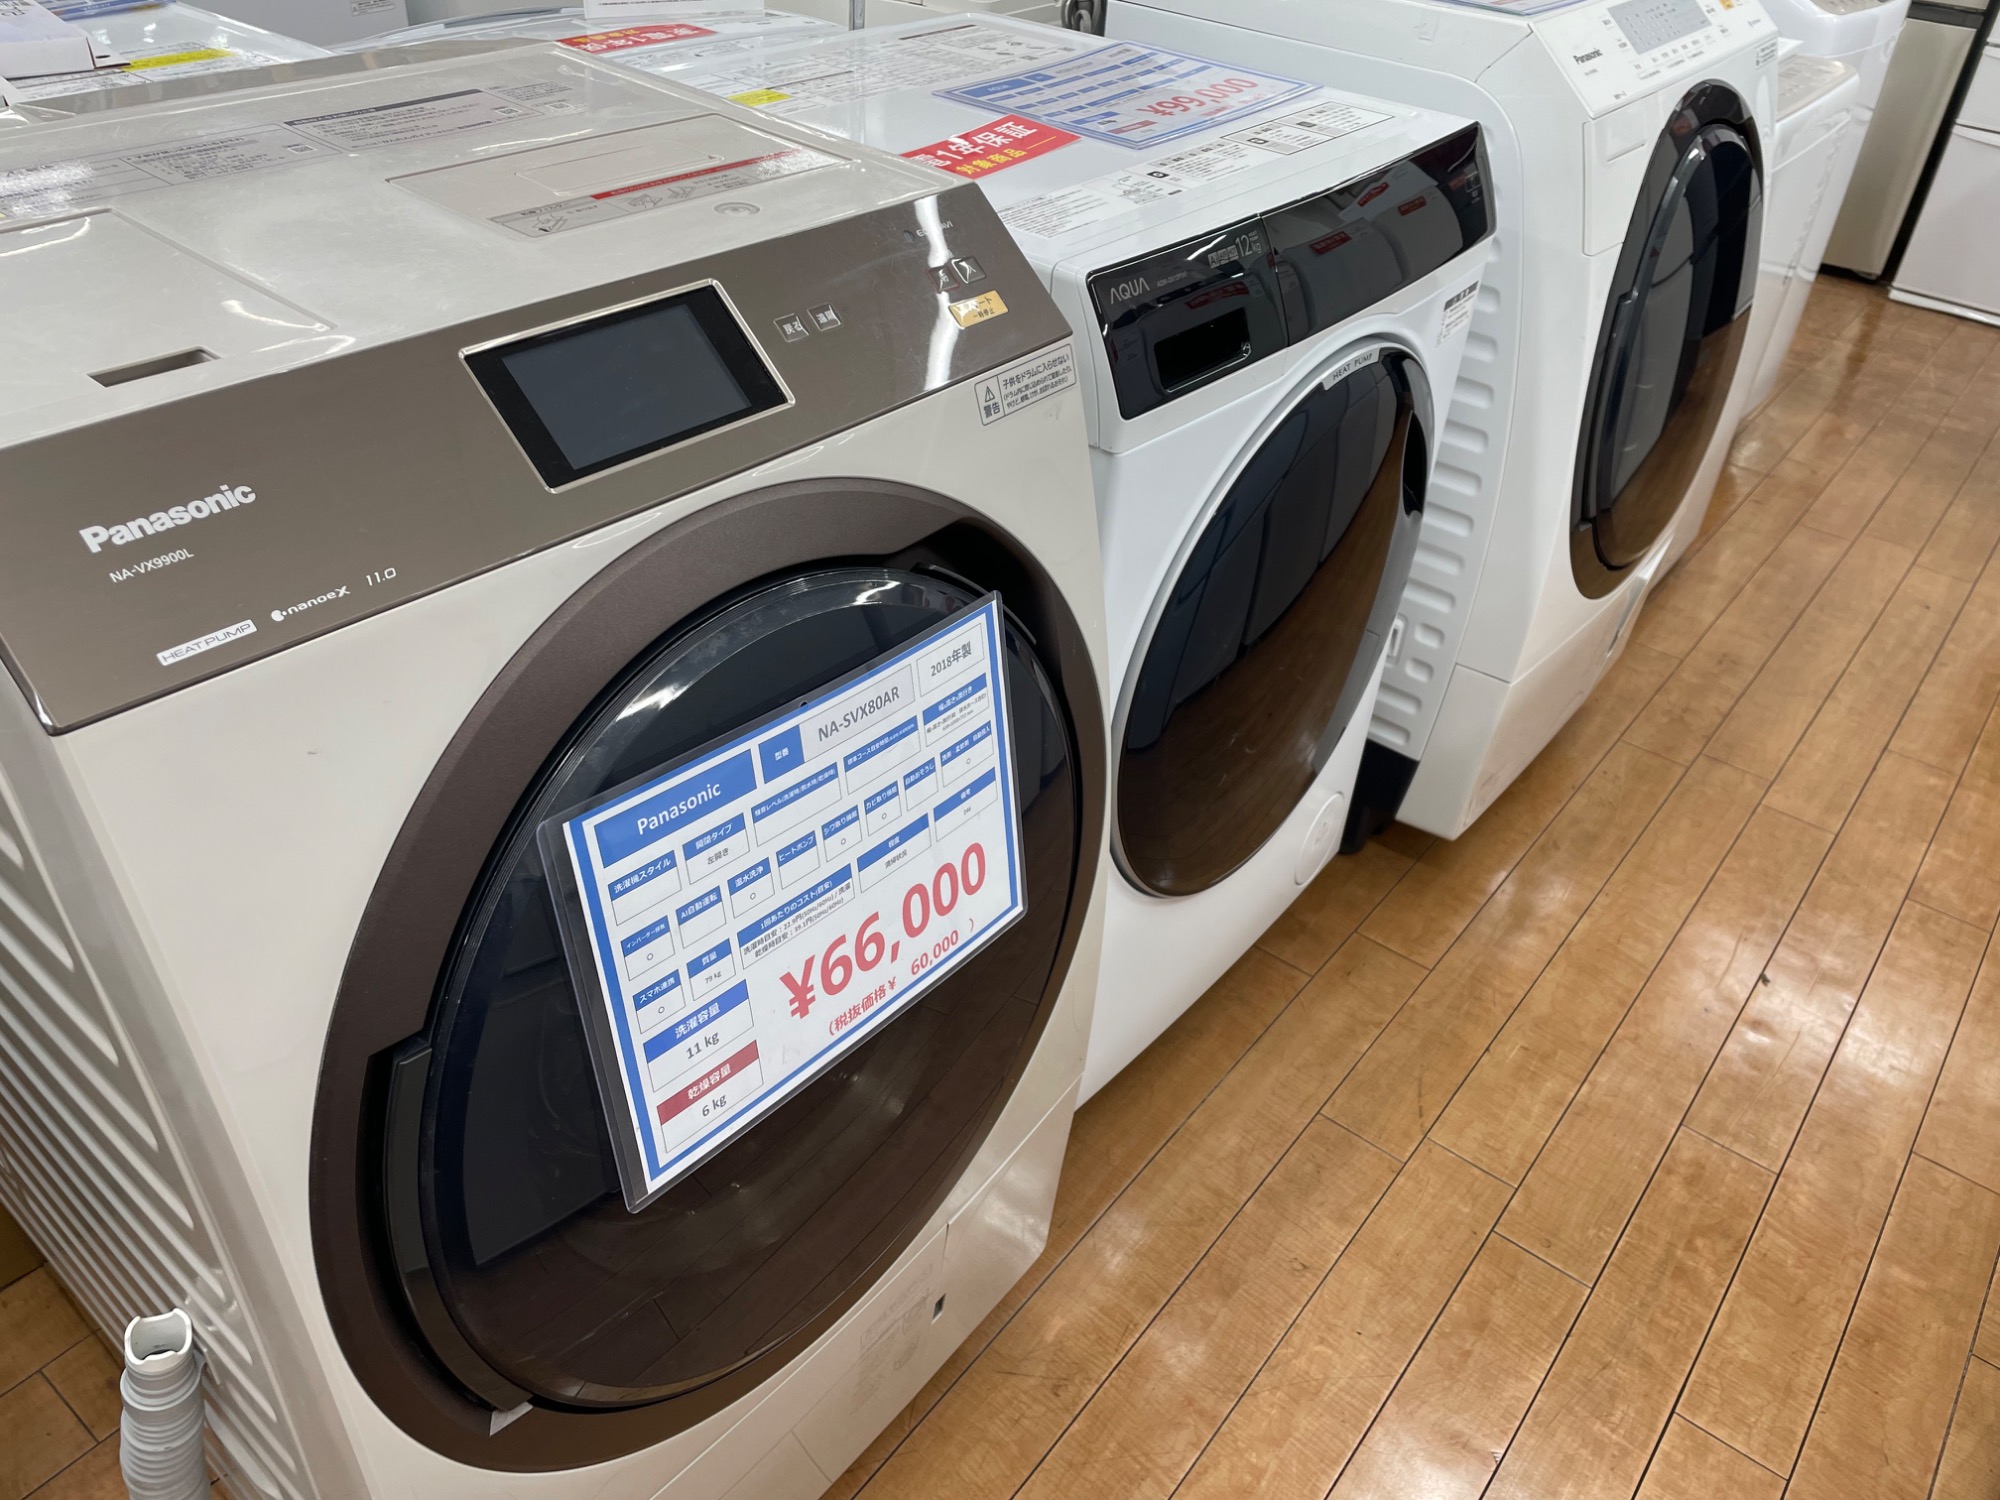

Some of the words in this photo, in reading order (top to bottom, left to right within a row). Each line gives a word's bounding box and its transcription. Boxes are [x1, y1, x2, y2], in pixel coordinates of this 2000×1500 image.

[1573, 48, 1603, 65] Panasonic
[1136, 78, 1258, 116] ¥99,000
[956, 148, 1028, 175] 対象商品
[1235, 234, 1253, 257] 12
[1252, 242, 1262, 254] kg
[1110, 277, 1150, 304] AQUA
[783, 321, 803, 335] 戻る
[1002, 354, 1069, 390] 子供をドラムに入らせない
[1333, 363, 1351, 380] HEAT
[1354, 353, 1372, 367] PUMP
[984, 402, 1000, 418] 警告
[79, 484, 257, 553] Panasonic
[109, 548, 194, 583] NA-VX9900L
[365, 567, 397, 586] 11.0
[162, 641, 203, 662] HEAT
[204, 623, 251, 646] PUMP
[930, 641, 972, 677] 2018年製
[818, 686, 900, 742] NA-SVX80AR
[905, 761, 935, 786] 自動おそうじ
[636, 782, 721, 835] Panasonic
[695, 823, 732, 850] 開閉タイプ
[778, 836, 815, 862] ヒートポンプ
[707, 848, 729, 865] 左開き
[614, 857, 671, 893] 洗濯機スタイル
[735, 865, 764, 888] 温水洗浄
[681, 892, 718, 919] AI自動運転
[760, 880, 833, 930] 1回あたりのコスト(目安)
[779, 842, 986, 1020] ¥66,000
[911, 929, 959, 976] 60,000
[639, 976, 676, 1004] スマホ連携
[705, 975, 713, 985] 79
[713, 970, 722, 979] kg
[675, 1003, 721, 1039] 洗濯容量
[685, 1043, 702, 1060] 11
[704, 1031, 720, 1050] kg
[687, 1063, 731, 1100] 乾燥容量
[702, 1105, 710, 1117] 6
[712, 1095, 727, 1111] kg
